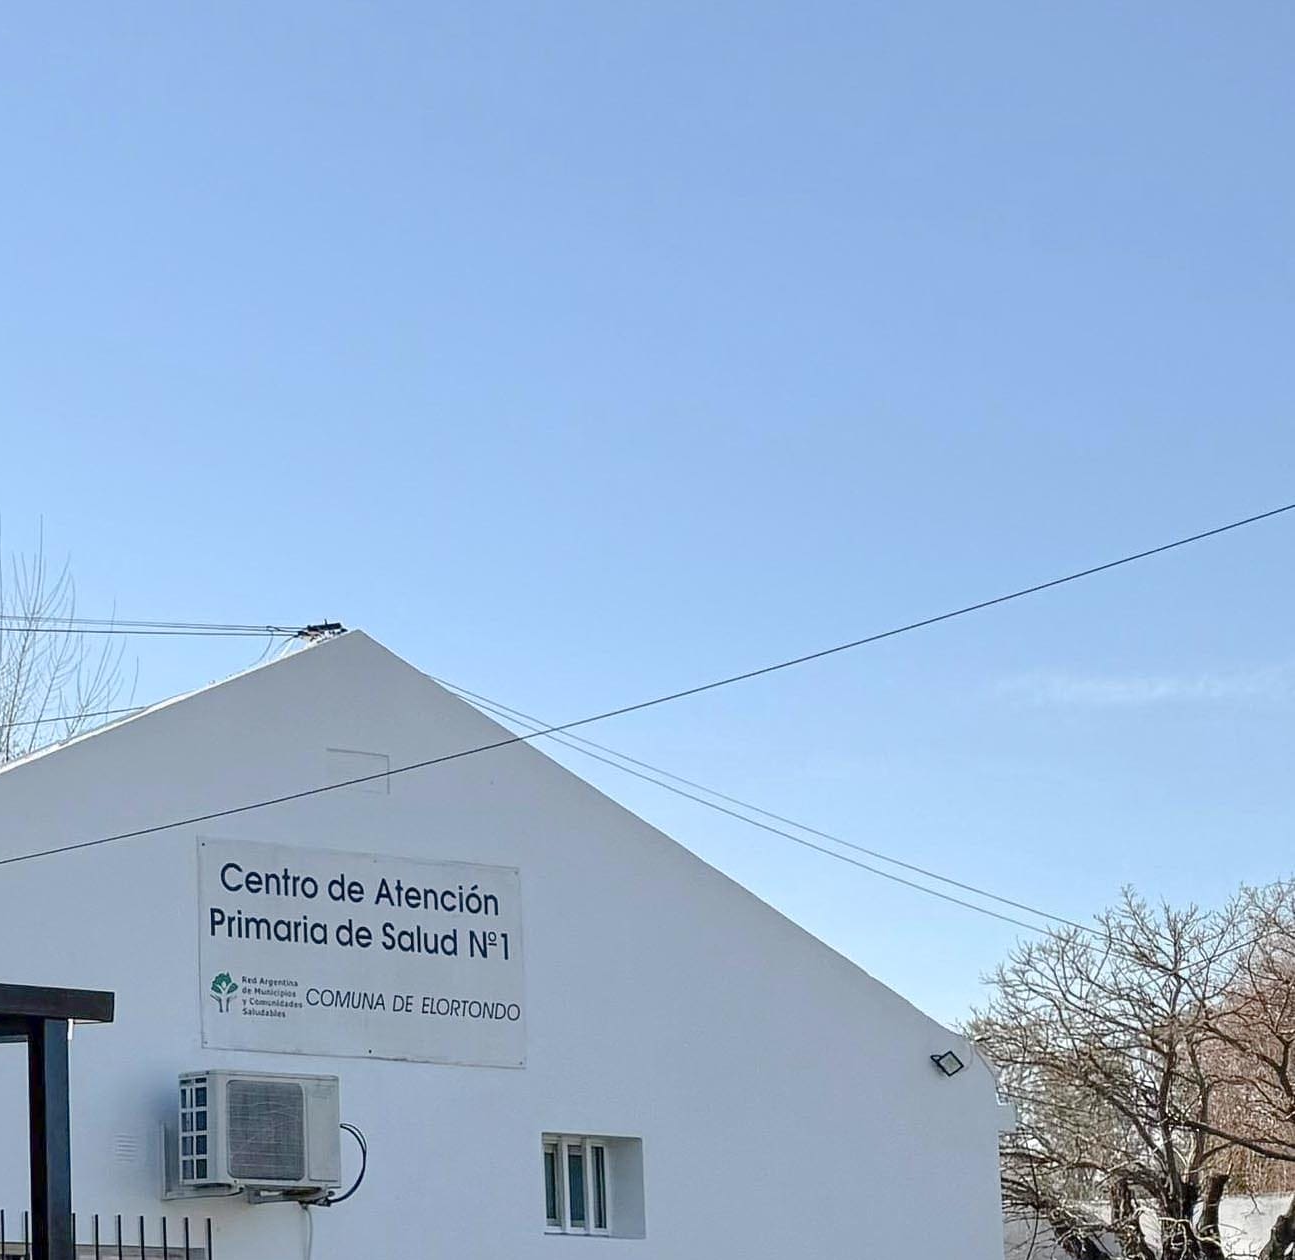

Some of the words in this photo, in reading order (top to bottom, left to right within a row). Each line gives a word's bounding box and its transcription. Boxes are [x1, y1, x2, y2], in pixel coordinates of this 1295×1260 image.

[220, 862, 319, 900] Centro
[327, 873, 365, 903] de
[374, 878, 499, 916] Atención
[210, 907, 328, 945] Primaria
[336, 919, 373, 948] de
[381, 922, 458, 956] Salud
[241, 976, 258, 984] Red
[259, 977, 299, 987] Argentina
[241, 986, 252, 995] de
[254, 987, 297, 998] Municipios
[249, 997, 303, 1008] Comunidades
[305, 987, 387, 1012] COMUNA
[392, 994, 414, 1013] DE
[422, 997, 521, 1022] ELORTONDO
[241, 1007, 286, 1018] Saludables
